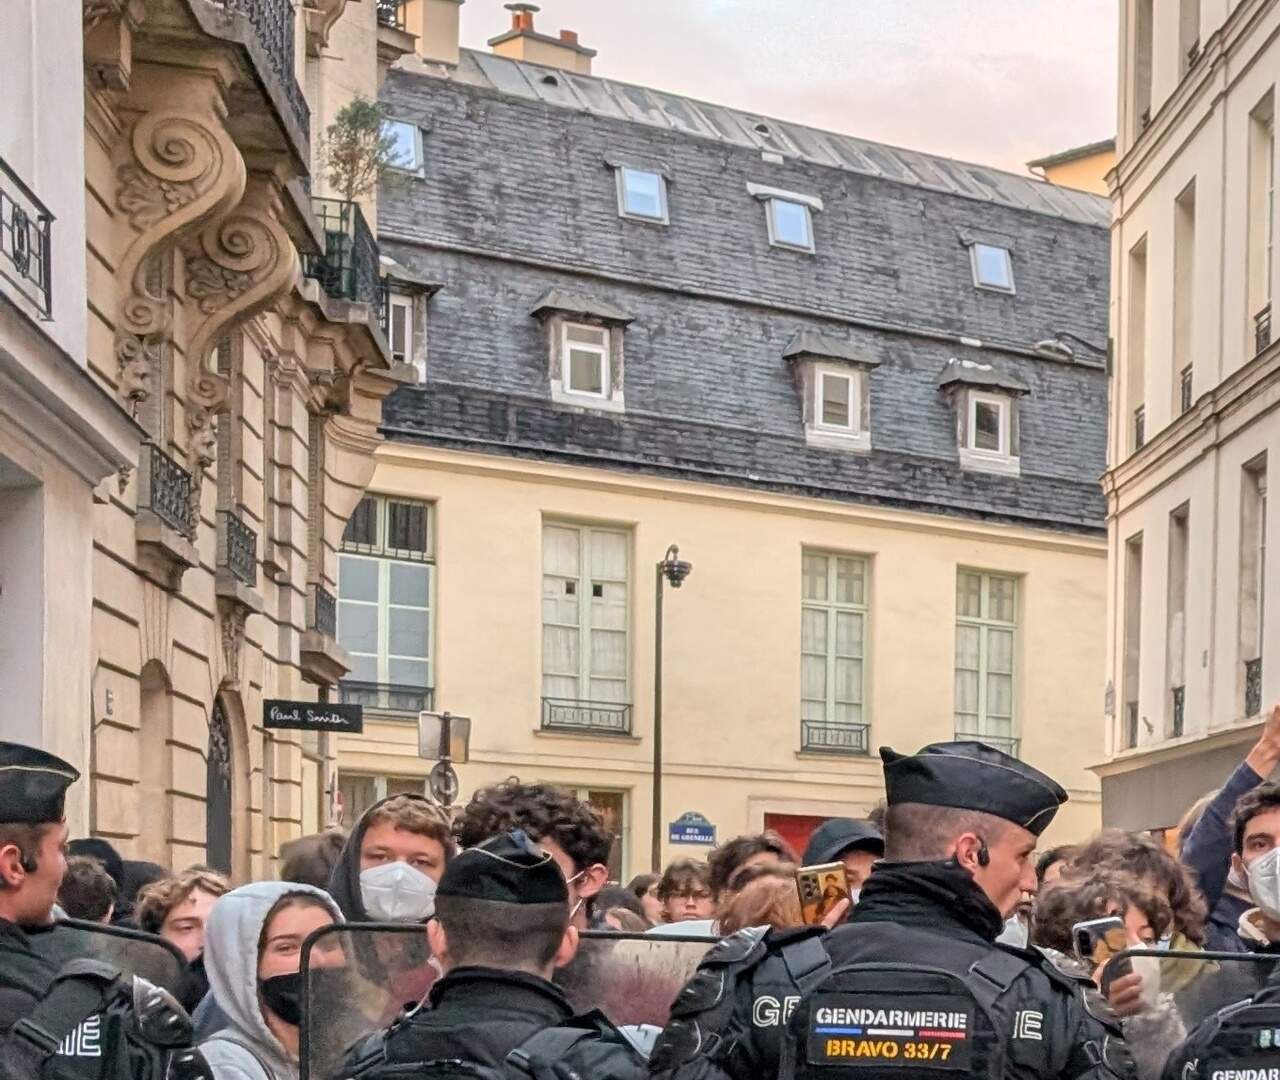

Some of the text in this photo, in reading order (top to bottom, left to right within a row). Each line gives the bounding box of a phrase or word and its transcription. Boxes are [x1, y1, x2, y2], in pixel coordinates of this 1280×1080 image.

[270, 706, 301, 720] Paul
[815, 1007, 967, 1029] GENDARMERIE
[826, 1040, 952, 1061] BRAVO 33/7
